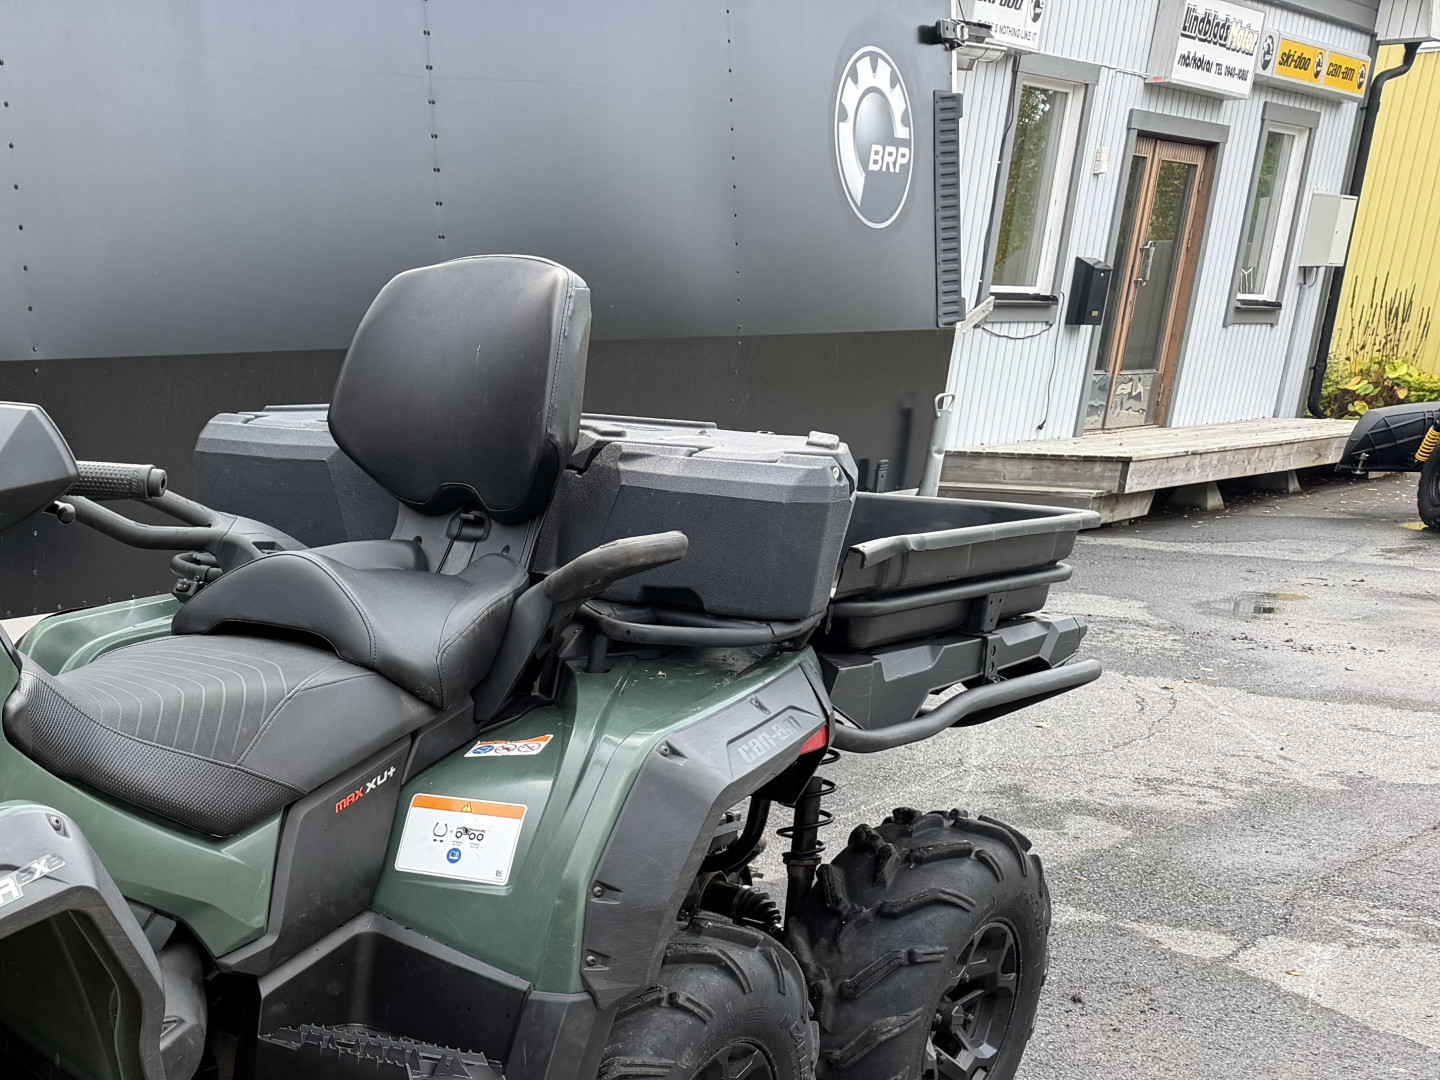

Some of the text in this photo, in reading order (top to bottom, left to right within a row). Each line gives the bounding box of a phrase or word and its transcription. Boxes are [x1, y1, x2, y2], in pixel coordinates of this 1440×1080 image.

[998, 25, 1021, 38] NOTHING
[1020, 30, 1032, 41] LIKE
[1180, 4, 1259, 56] Lindblads Motor
[1278, 49, 1311, 71] ski-doo
[1326, 62, 1355, 81] can-am
[868, 144, 909, 173] BRP
[737, 715, 802, 763] can-am
[335, 786, 364, 813] MAX
